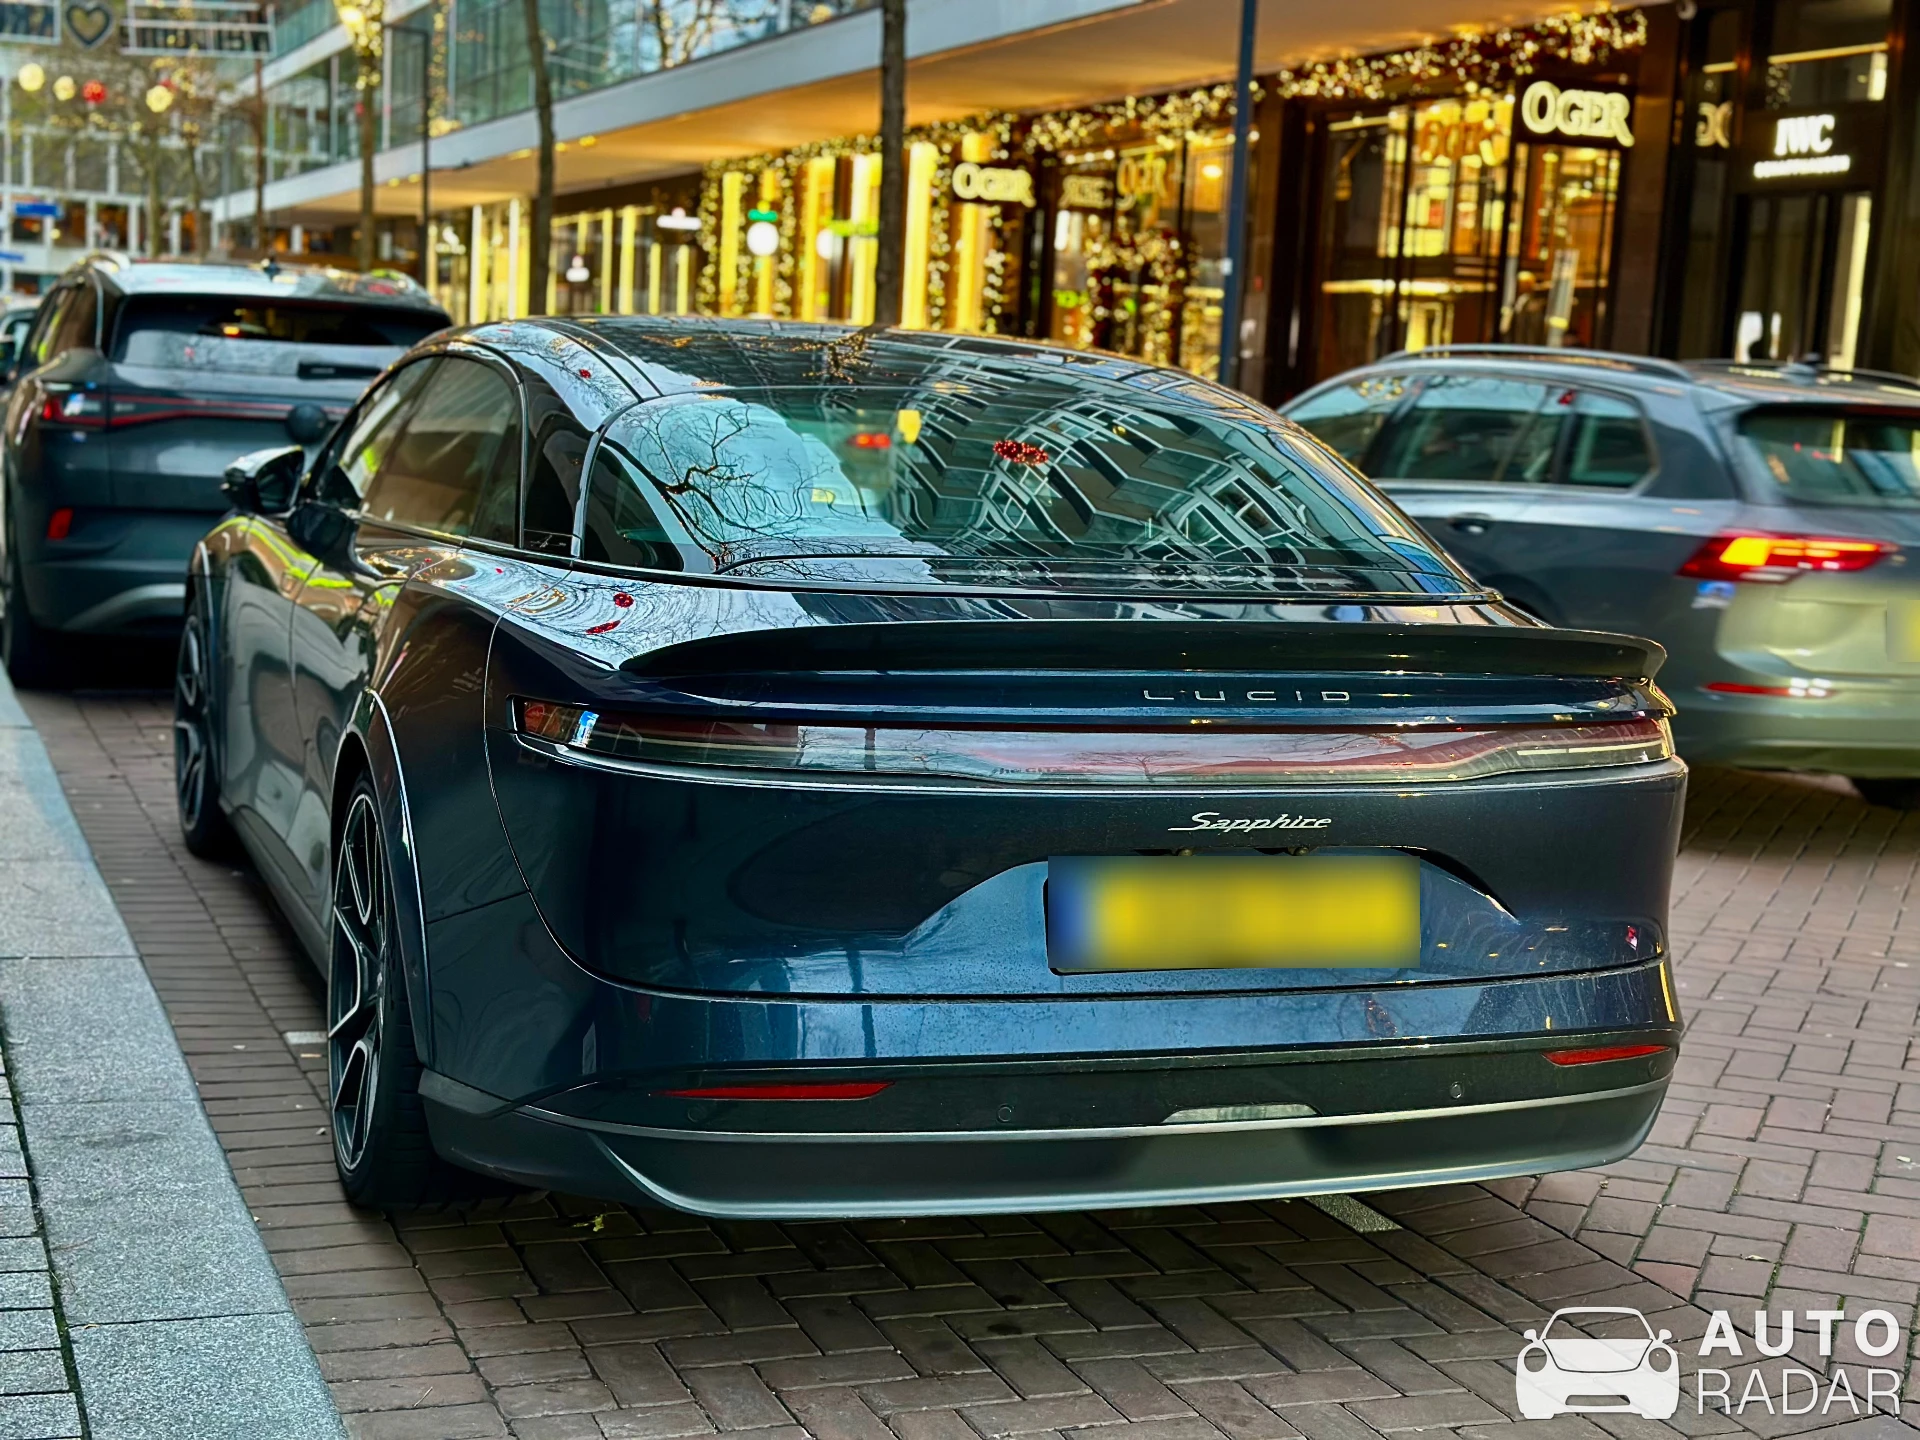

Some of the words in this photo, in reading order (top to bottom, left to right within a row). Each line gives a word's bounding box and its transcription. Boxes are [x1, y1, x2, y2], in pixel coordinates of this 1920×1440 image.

[1522, 80, 1635, 147] OGER
[1774, 114, 1836, 157] IWC
[1143, 689, 1350, 702] LUCID
[1168, 811, 1332, 833] Sapphire
